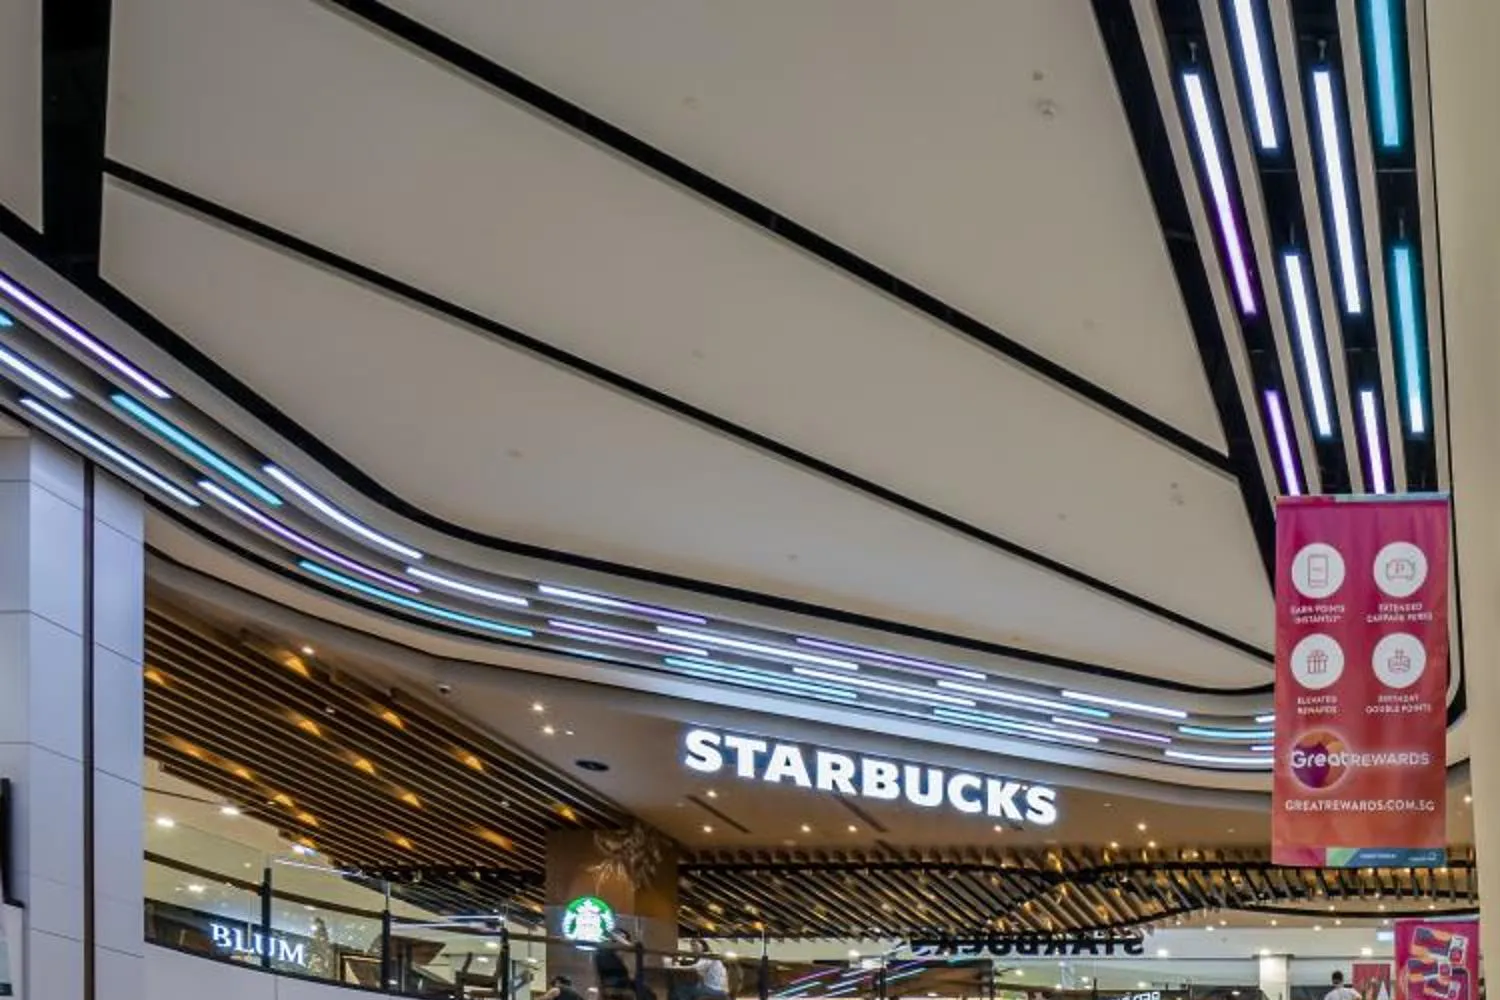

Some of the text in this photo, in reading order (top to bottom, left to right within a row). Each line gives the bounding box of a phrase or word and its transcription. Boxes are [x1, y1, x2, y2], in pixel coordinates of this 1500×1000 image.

[684, 729, 1057, 824] STARBUCKS
[1285, 799, 1436, 813] GREATREWARDS.COM.SG
[210, 922, 306, 968] BLUM
